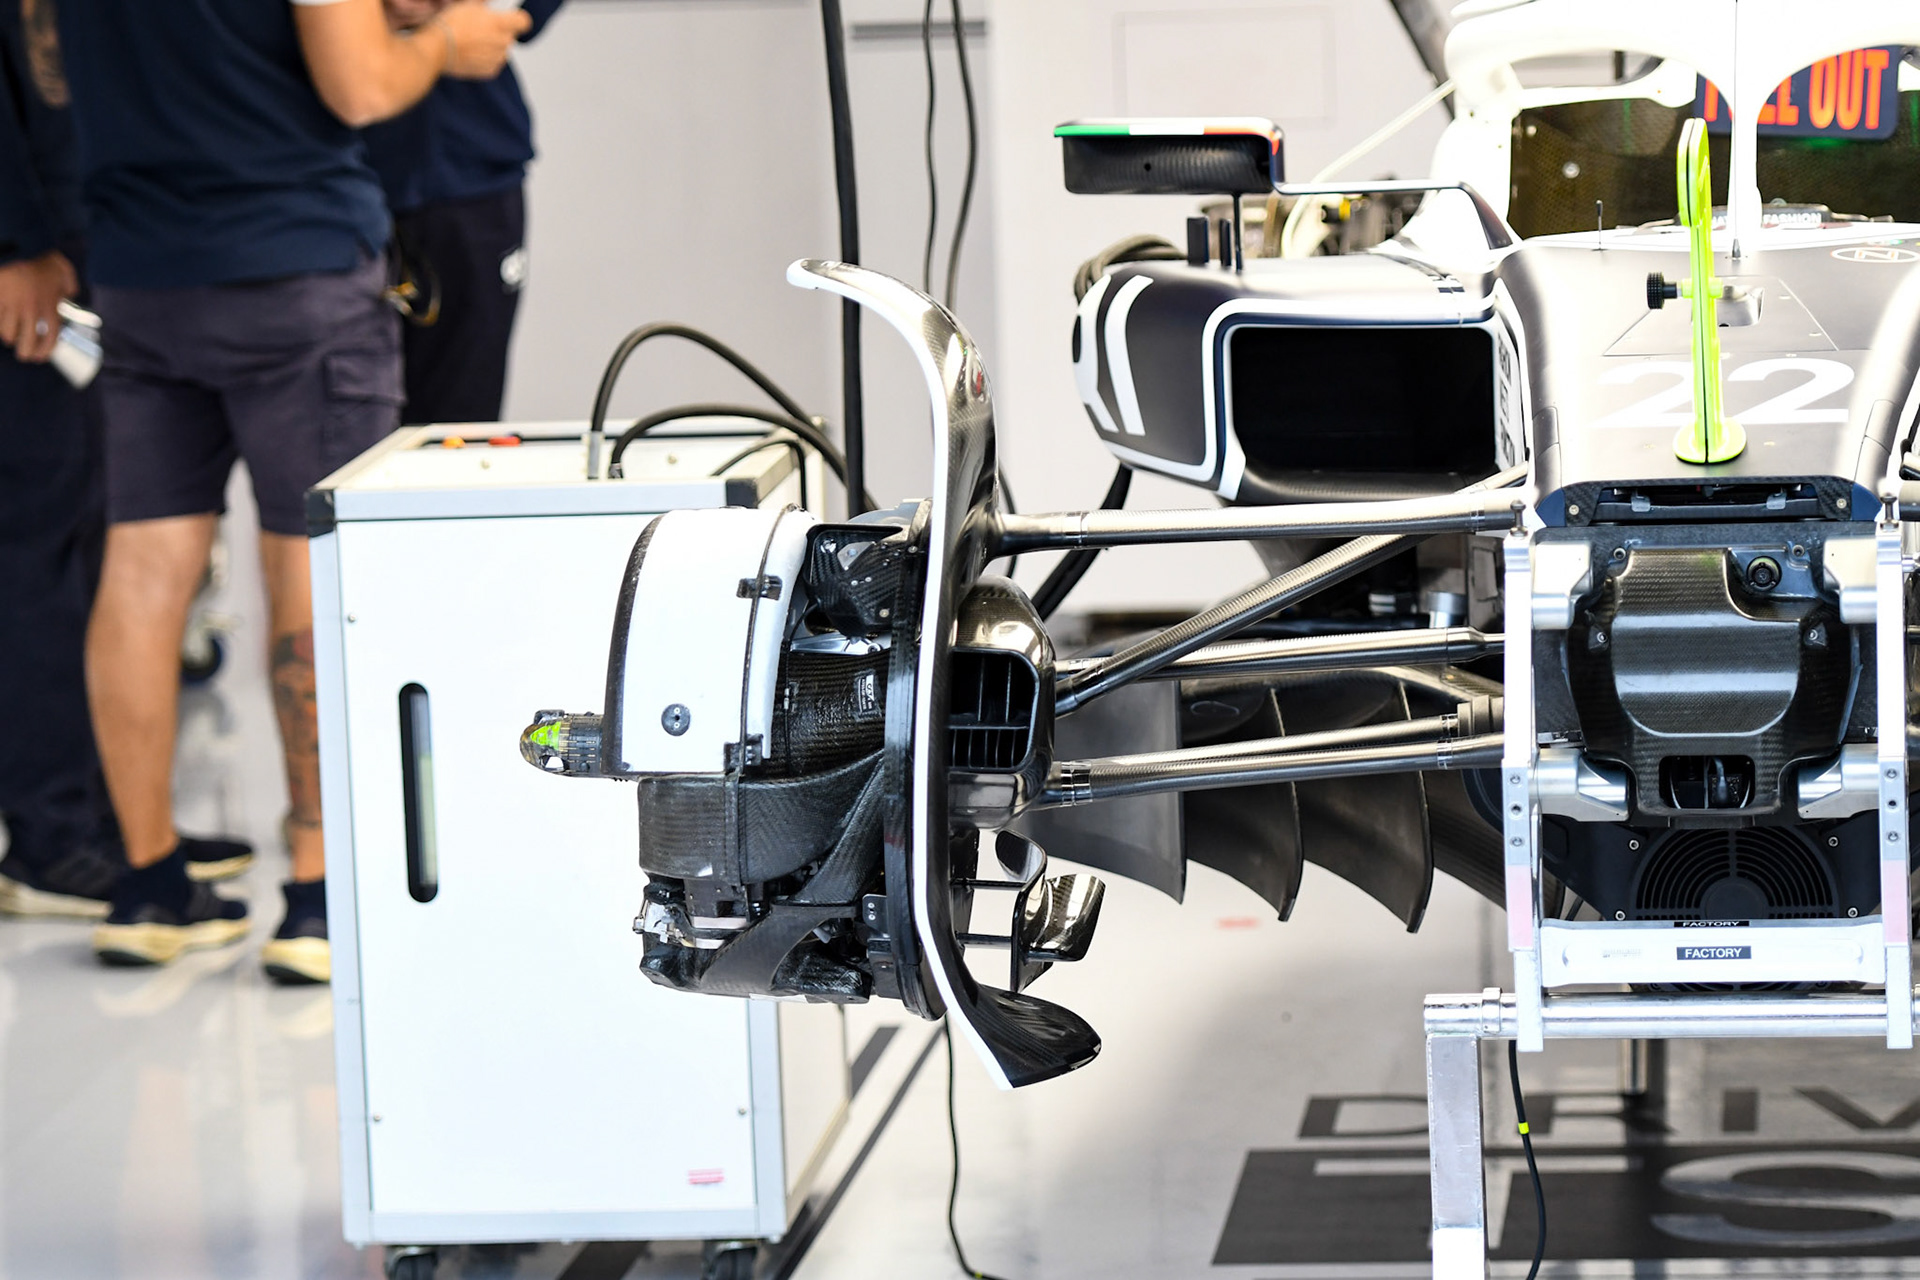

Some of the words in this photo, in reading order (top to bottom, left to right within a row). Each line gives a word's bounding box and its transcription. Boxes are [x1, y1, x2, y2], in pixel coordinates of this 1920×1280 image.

[1809, 49, 1889, 130] OUT
[1763, 213, 1821, 224] FASHION
[1594, 357, 1855, 428] 22
[1685, 948, 1742, 958] FACTORY
